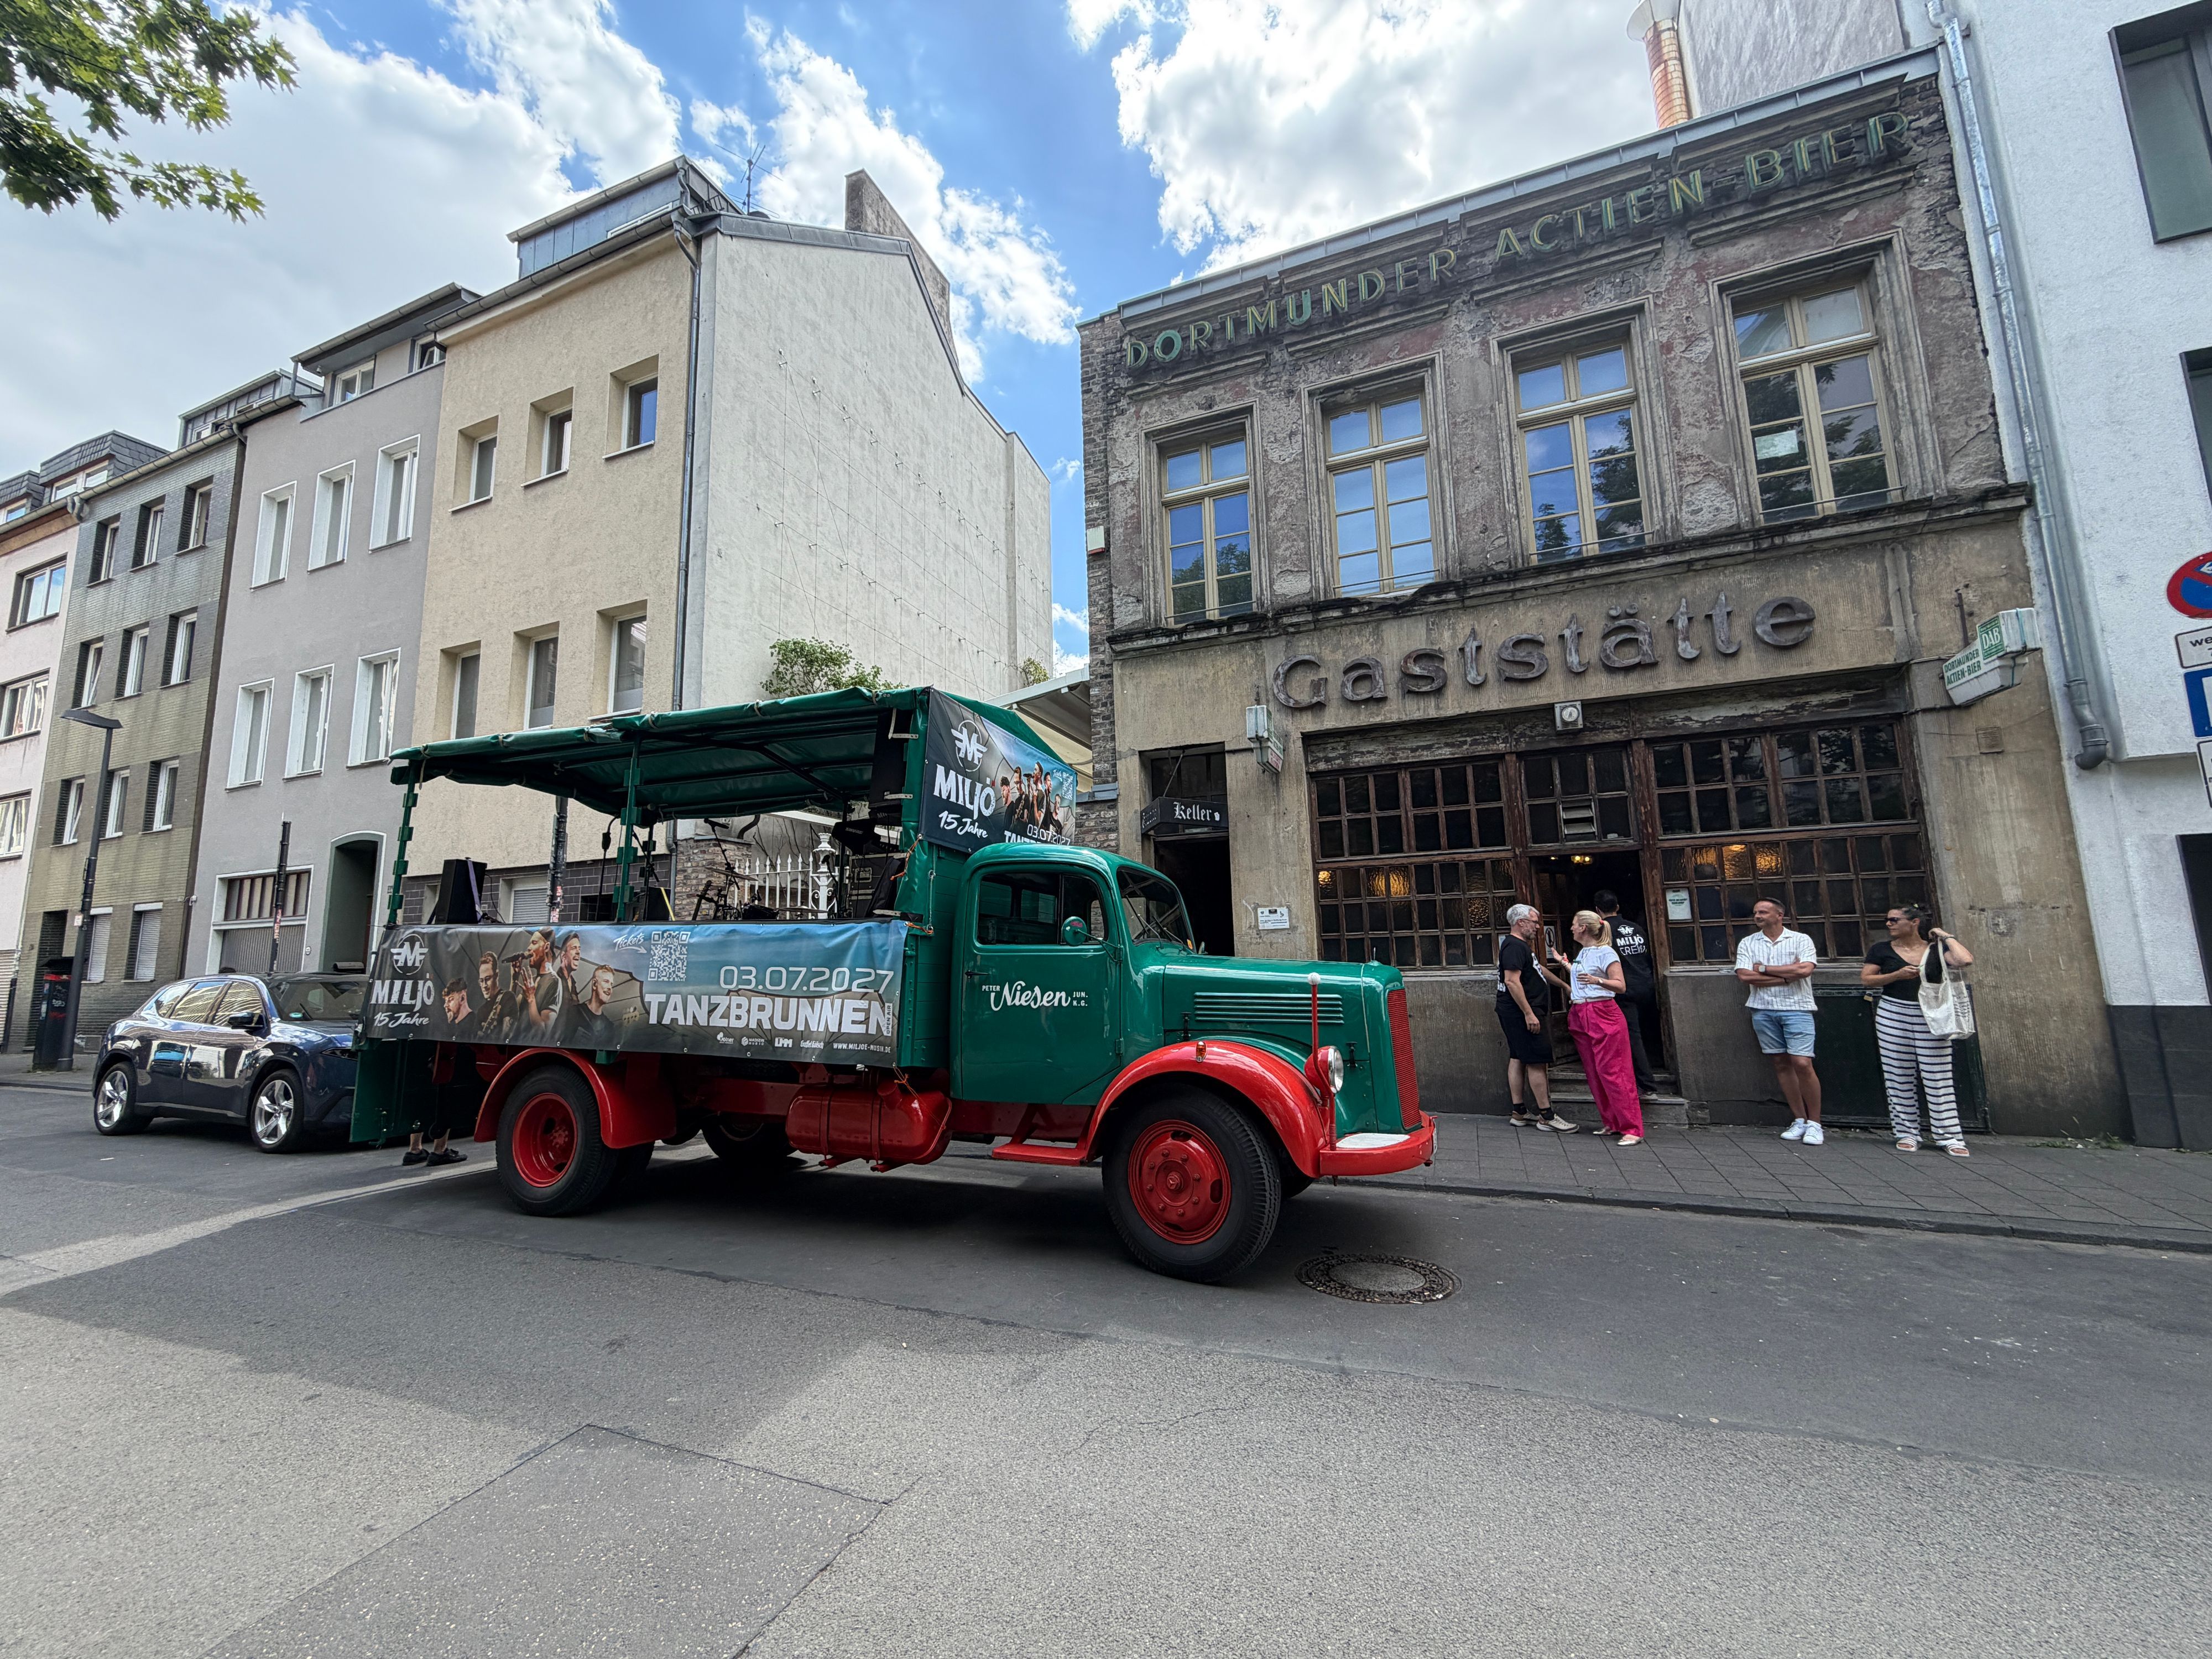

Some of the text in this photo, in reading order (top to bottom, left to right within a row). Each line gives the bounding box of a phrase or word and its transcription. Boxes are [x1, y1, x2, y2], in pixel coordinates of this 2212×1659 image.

[1126, 248, 1460, 371] DORTMUNDER
[1271, 590, 1816, 709] Gaststätte
[1982, 627, 2001, 650] DAB
[1944, 648, 1980, 674] DORTMUNDER
[938, 810, 961, 830] 15
[957, 818, 989, 838] Jahre
[1172, 801, 1212, 821] Keller
[1027, 823, 1071, 847] 03.07.2027
[613, 932, 645, 952] Tickets
[1619, 945, 1646, 956] CREW
[720, 965, 895, 995] 03.07.2027
[990, 980, 1071, 1011] Niesen
[374, 1011, 430, 1028] 15 Jahre
[644, 993, 890, 1036] TANZBRUNNEN
